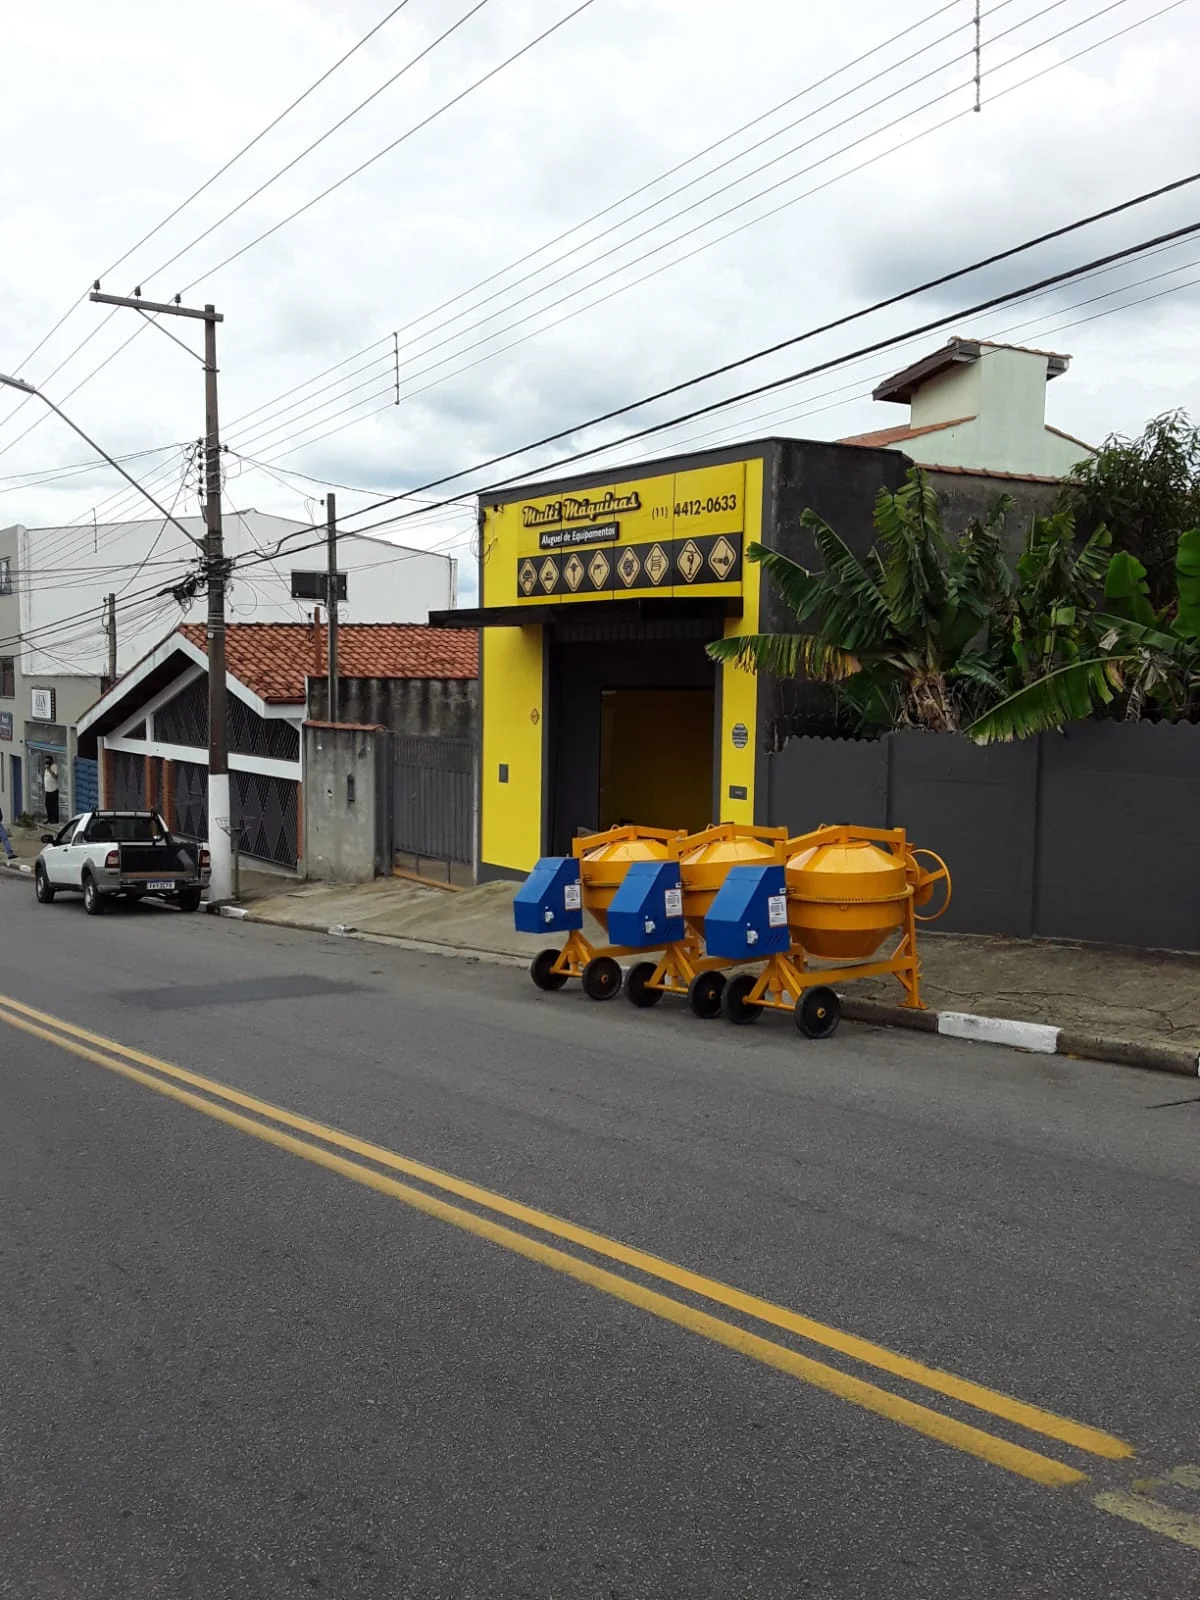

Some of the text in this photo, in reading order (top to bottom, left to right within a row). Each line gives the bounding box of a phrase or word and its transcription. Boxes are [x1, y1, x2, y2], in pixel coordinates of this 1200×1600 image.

[523, 492, 641, 527] Multi Máquinas
[652, 495, 737, 520] (11) 4412-0633
[541, 526, 615, 547] Aluguel de Equipamentos
